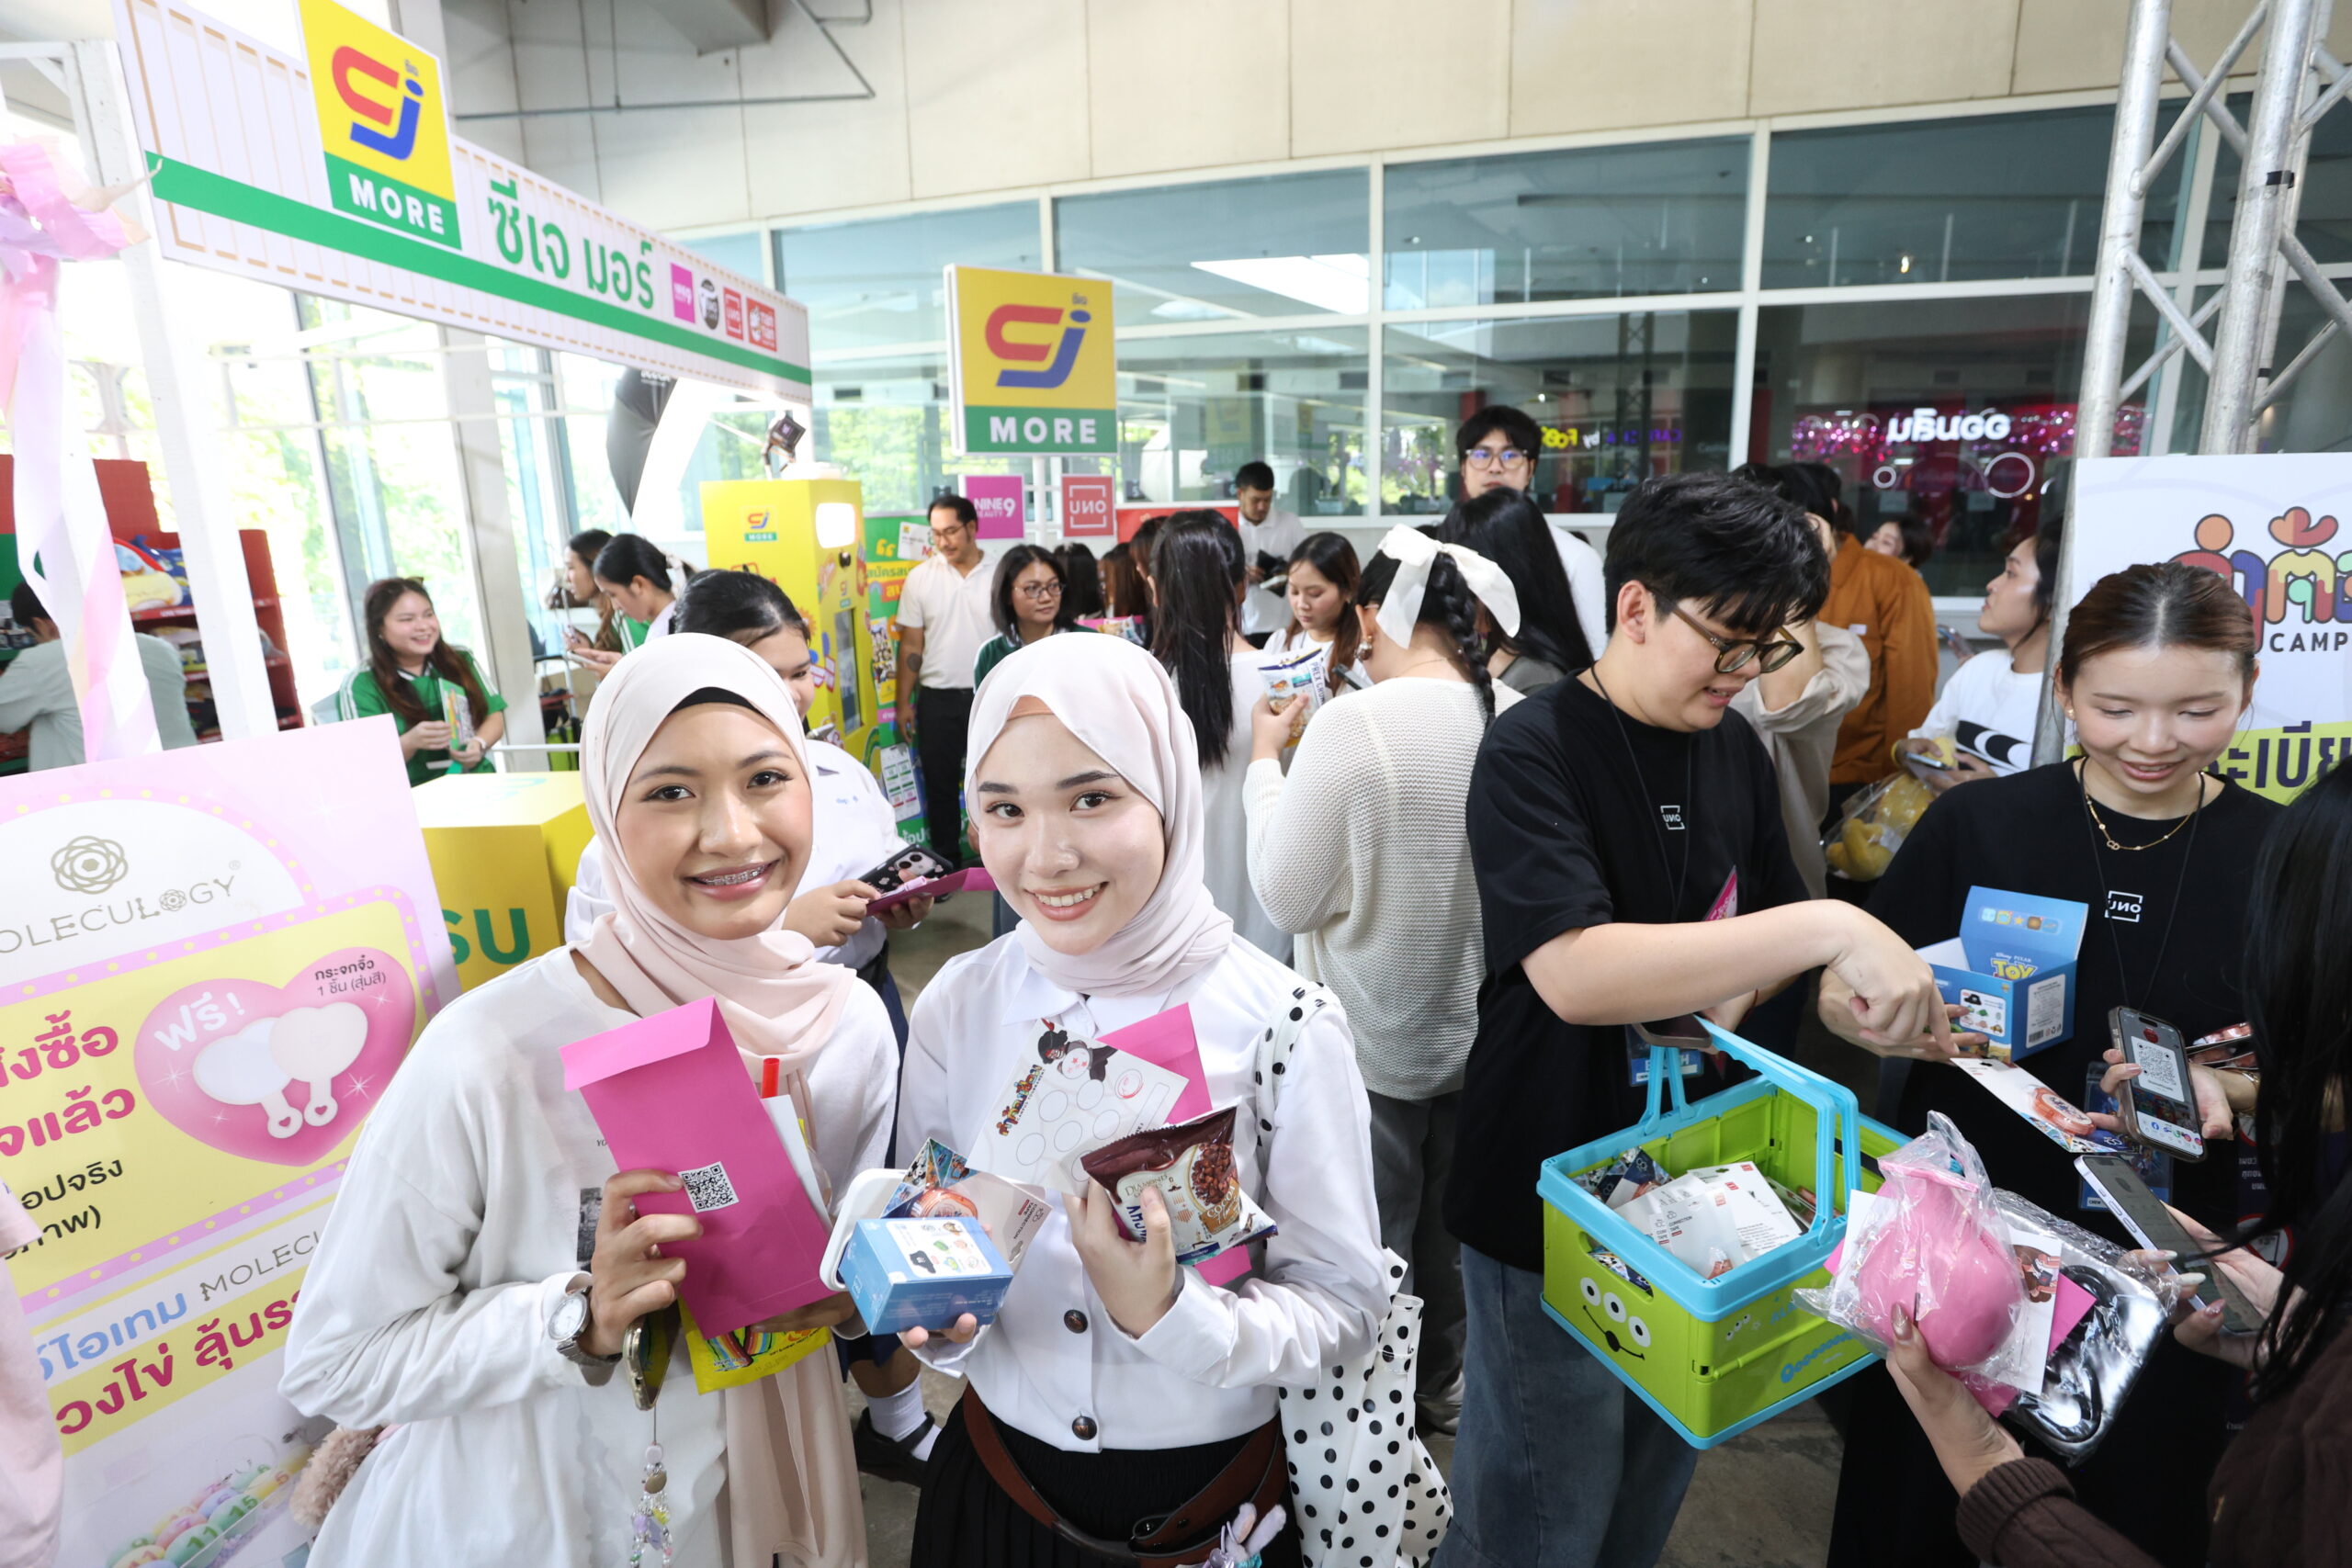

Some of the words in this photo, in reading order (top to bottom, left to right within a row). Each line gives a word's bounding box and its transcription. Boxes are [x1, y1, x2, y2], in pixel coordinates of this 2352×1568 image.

[348, 173, 445, 236] MORE
[487, 178, 570, 280] ซีเจ
[582, 239, 654, 310] มอร์
[989, 415, 1097, 445] MORE
[973, 497, 1003, 511] NINE
[1069, 500, 1107, 514] UNO
[2268, 632, 2348, 653] CAMP
[2208, 720, 2352, 789] ะเบีย
[1991, 959, 2037, 981] TOY
[317, 986, 323, 997] 1
[0, 1010, 119, 1088] งซื้อ
[194, 1290, 300, 1371] ลุ้นร
